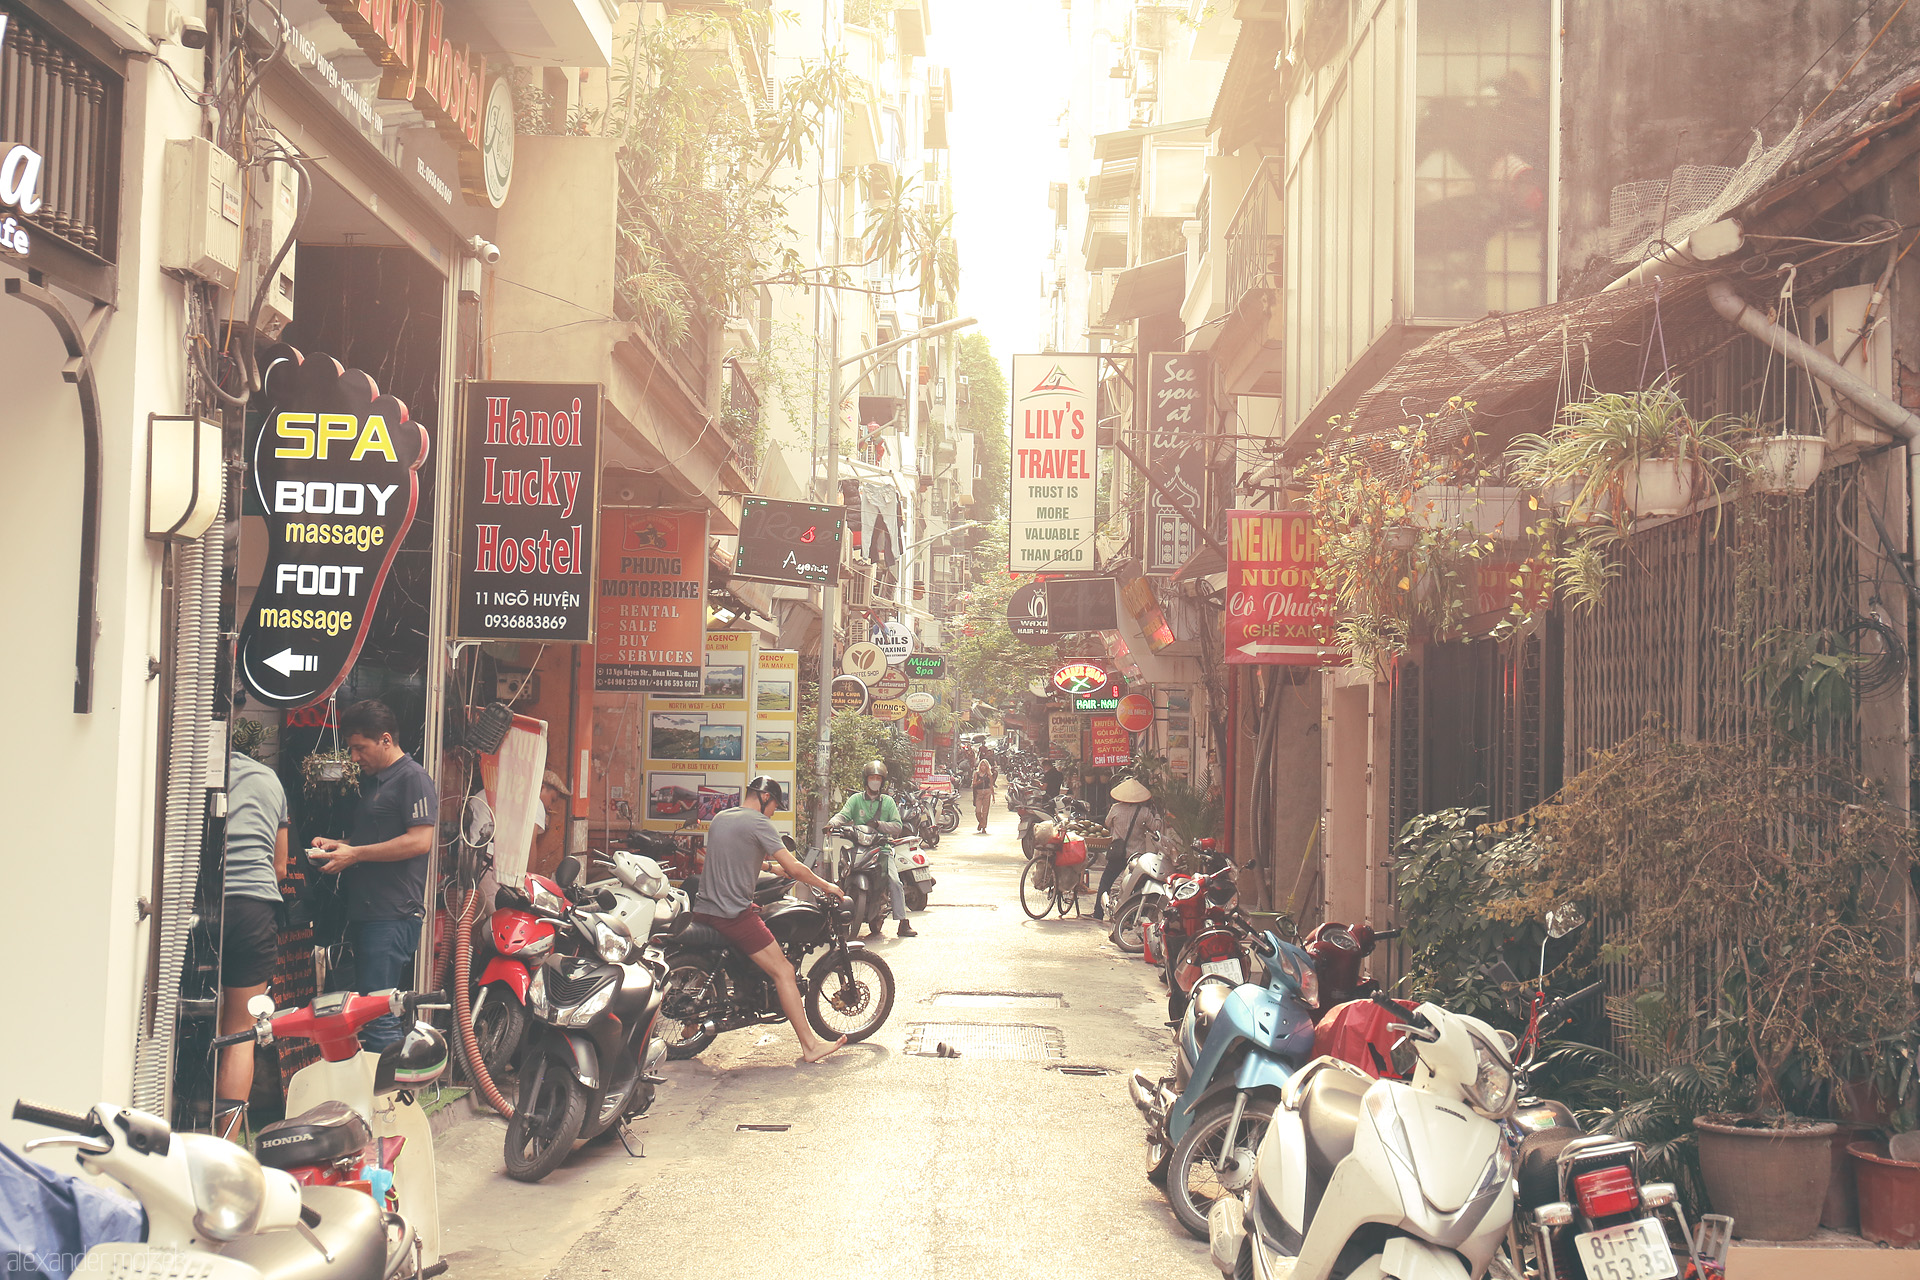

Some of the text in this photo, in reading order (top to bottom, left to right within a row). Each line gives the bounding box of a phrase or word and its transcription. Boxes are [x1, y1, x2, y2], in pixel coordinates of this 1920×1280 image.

[425, 0, 487, 150] Hostel
[317, 53, 338, 88] HUYỆN
[340, 77, 359, 109] HOÀN
[374, 112, 383, 135] HN
[0, 216, 29, 254] fe
[1163, 359, 1196, 383] See
[1157, 388, 1200, 408] you
[484, 397, 583, 447] Hanoi
[1024, 401, 1085, 440] LILY'S
[1166, 403, 1191, 423] at
[275, 412, 398, 462] SPA
[1018, 449, 1090, 479] TRAVEL
[482, 457, 582, 518] Lucky
[1028, 486, 1078, 499] TRUST IS
[275, 481, 399, 516] BODY
[1036, 507, 1069, 520] MORE
[285, 523, 384, 552] massage
[1025, 527, 1080, 541] VALUABLE
[1231, 517, 1331, 563] NEM CH
[474, 525, 583, 575] Hostel
[1020, 548, 1083, 562] THAN GOLD
[620, 556, 682, 576] PHUNG
[1240, 566, 1337, 587] NƯỚN
[276, 564, 364, 597] FOOT
[600, 579, 700, 600] MOTORBIKE
[475, 590, 580, 610] 11 NGÕ HUYỆN
[1229, 591, 1256, 617] Cô
[619, 604, 681, 618] RENTAL
[260, 608, 352, 636] massage
[484, 614, 567, 630] 0936883869
[619, 619, 657, 632] SALE
[1242, 618, 1283, 638] (GHẾ
[618, 634, 650, 647] BUY
[707, 634, 739, 642] AGENCY
[618, 649, 694, 664] SERVICES
[907, 657, 941, 667] Midori
[623, 669, 640, 678] Huyen
[683, 670, 699, 679] Hanoi
[915, 666, 934, 677] Spa
[262, 1133, 314, 1149] HONDA
[1590, 1225, 1652, 1260] 81-F1
[1592, 1249, 1671, 1280] 153.35
